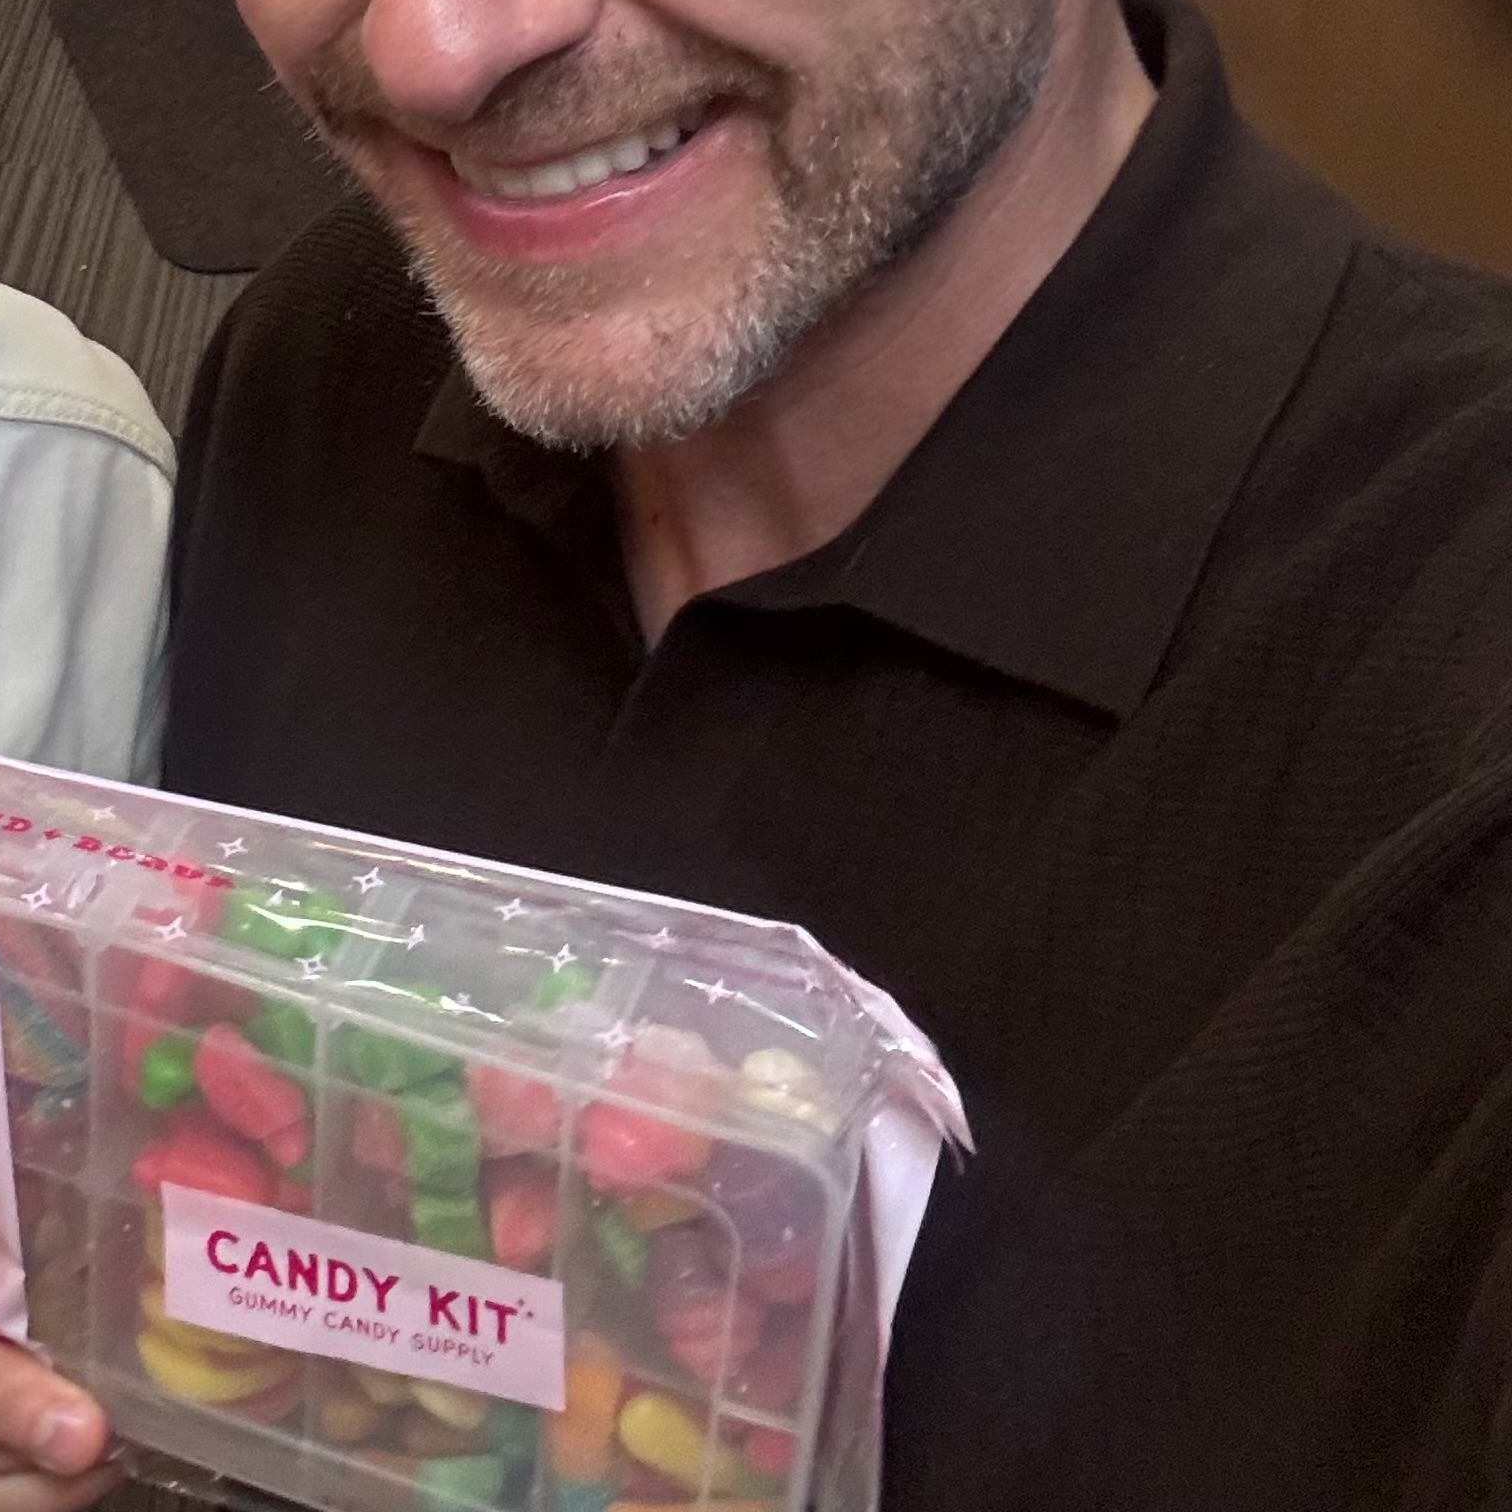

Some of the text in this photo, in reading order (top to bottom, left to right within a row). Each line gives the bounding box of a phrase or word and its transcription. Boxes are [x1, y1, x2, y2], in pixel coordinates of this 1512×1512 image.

[206, 1228, 519, 1345] CANDY KIT
[228, 1286, 496, 1368] GUMMY CANDY SUPPLY
